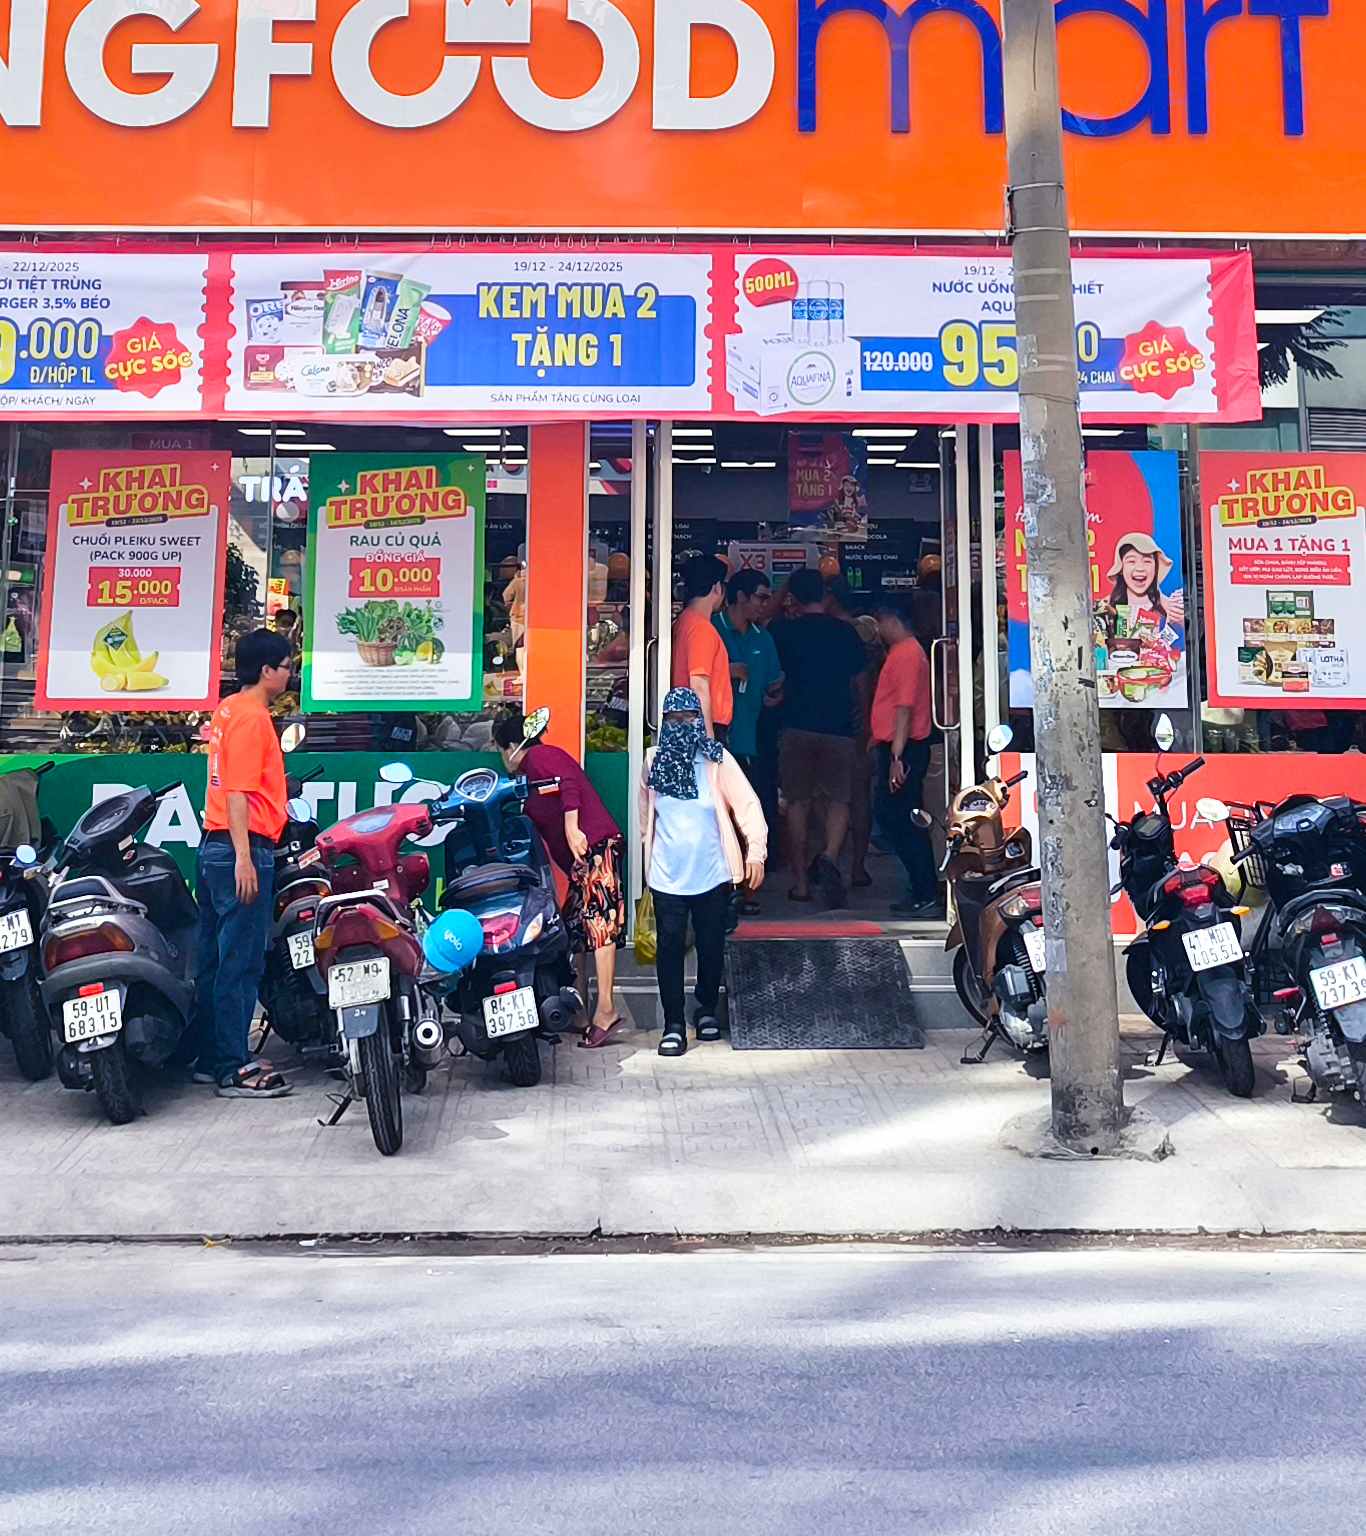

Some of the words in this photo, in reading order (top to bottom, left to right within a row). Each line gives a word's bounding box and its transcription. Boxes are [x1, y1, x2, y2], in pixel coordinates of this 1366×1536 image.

[13, 262, 79, 273] 22/12/2025
[514, 262, 546, 272] 19/12
[557, 262, 623, 272] 24/12/2025
[964, 266, 995, 276] 19/12
[16, 276, 48, 294] TIỆT
[51, 277, 102, 290] TRÙNG
[745, 271, 795, 294] 500ML
[933, 281, 973, 294] NƯỚC
[42, 298, 76, 310] 3,5%
[81, 296, 110, 309] BÉO
[479, 286, 546, 318] KEM
[557, 286, 625, 318] MUA
[637, 286, 657, 318] 2
[127, 332, 162, 353] GIÁ
[512, 325, 599, 378] TẶNG
[610, 333, 622, 367] 1
[1139, 335, 1173, 356] GIÁ
[104, 358, 146, 381] CỰC
[152, 349, 193, 373] SỐC
[863, 351, 933, 372] 120.000
[1120, 361, 1161, 382] CỰC
[1165, 351, 1205, 371] SỐC
[30, 363, 77, 388] Đ/HỘP
[81, 366, 95, 384] 1L
[791, 370, 832, 388] AQUAFINA
[1090, 372, 1115, 384] CHAI
[66, 394, 96, 406] NGÀY
[491, 392, 512, 403] SẢN
[517, 390, 547, 403] PHẨM
[552, 393, 579, 406] TẶNG
[583, 391, 613, 403] CÙNG
[617, 394, 641, 406] LOẠI
[149, 439, 181, 450] MUA
[102, 467, 178, 492] KHAI
[360, 468, 435, 495] KHAI
[797, 470, 819, 481] MUA
[824, 470, 831, 481] 2
[1249, 469, 1322, 494] KHAI
[71, 488, 205, 518] TRƯƠNG
[328, 490, 463, 521] TRƯƠNG
[1221, 490, 1352, 519] TRƯƠNG
[73, 533, 111, 545] CHUỐI
[115, 536, 155, 546] PLEIKU
[159, 536, 201, 546] SWEET
[350, 535, 380, 547] RAU
[385, 532, 405, 547] CỦ
[409, 532, 442, 547] QUẢ
[1229, 538, 1268, 551] MUA
[1274, 538, 1283, 551] 1
[1288, 535, 1335, 555] TẶNG
[1342, 539, 1350, 551] 1
[90, 551, 125, 561] (PACK
[128, 551, 158, 561] 900G
[162, 551, 182, 561] UP)
[405, 550, 425, 563] GIÁ
[740, 554, 766, 569] X3
[118, 569, 152, 578] 30.000
[359, 567, 432, 592] 10.000
[97, 580, 172, 604] 15.000
[443, 927, 463, 951] yolo
[1193, 945, 1238, 967] 405.54
[1318, 962, 1361, 986] 59-K1
[71, 995, 111, 1020] 59-U1
[490, 993, 527, 1015] 84-K1
[68, 1011, 118, 1038] 683.15
[488, 1010, 536, 1036] 397.56
